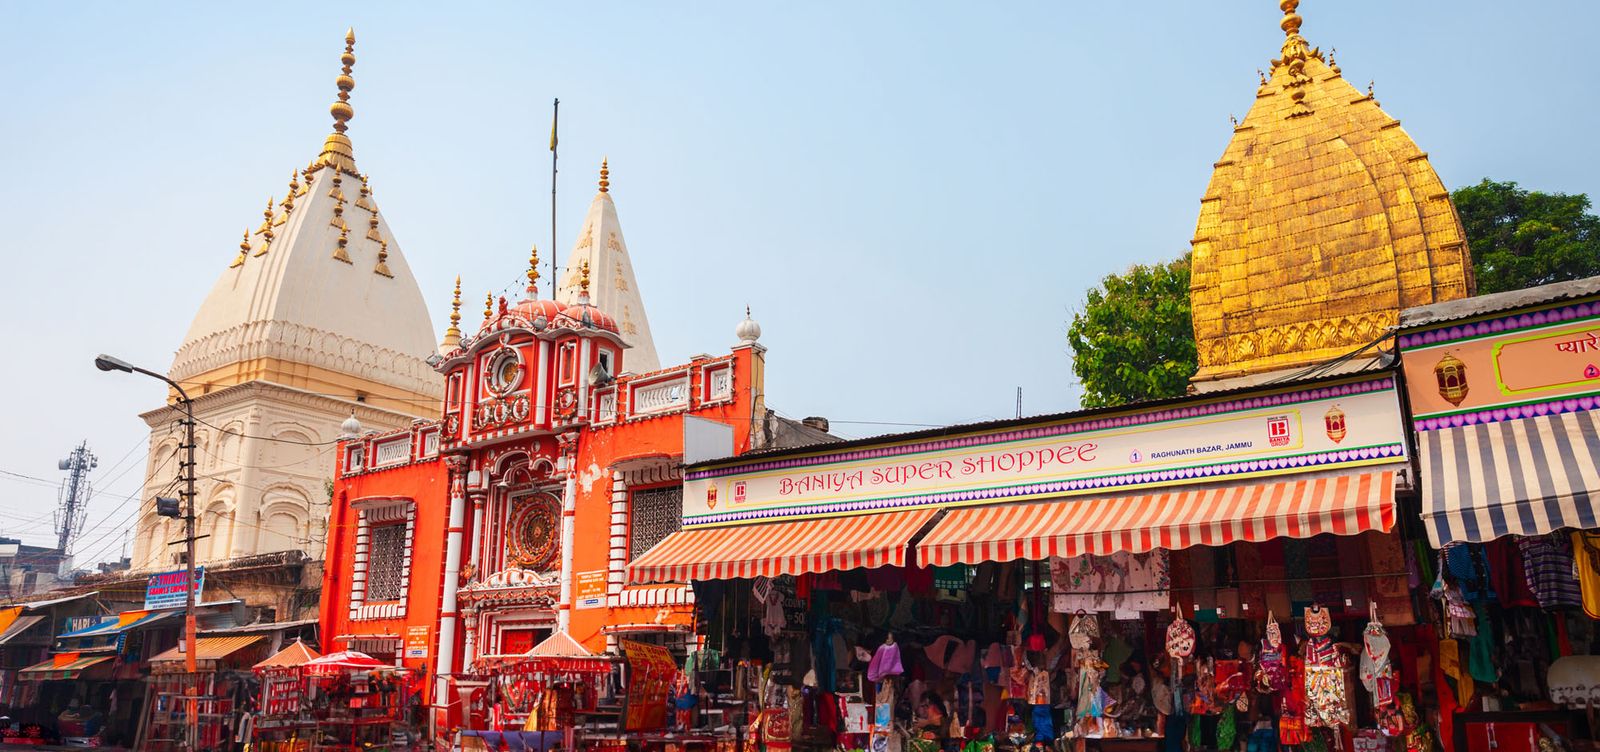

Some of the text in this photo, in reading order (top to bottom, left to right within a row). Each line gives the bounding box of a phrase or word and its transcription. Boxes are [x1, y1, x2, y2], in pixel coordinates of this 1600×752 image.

[1588, 367, 1596, 376] 2
[1151, 448, 1195, 459] RAGHUNATH
[1196, 444, 1224, 454] BAZAR,
[1225, 441, 1253, 450] JAMMU
[779, 443, 1098, 496] BANIYA SUPER SHOPPEE
